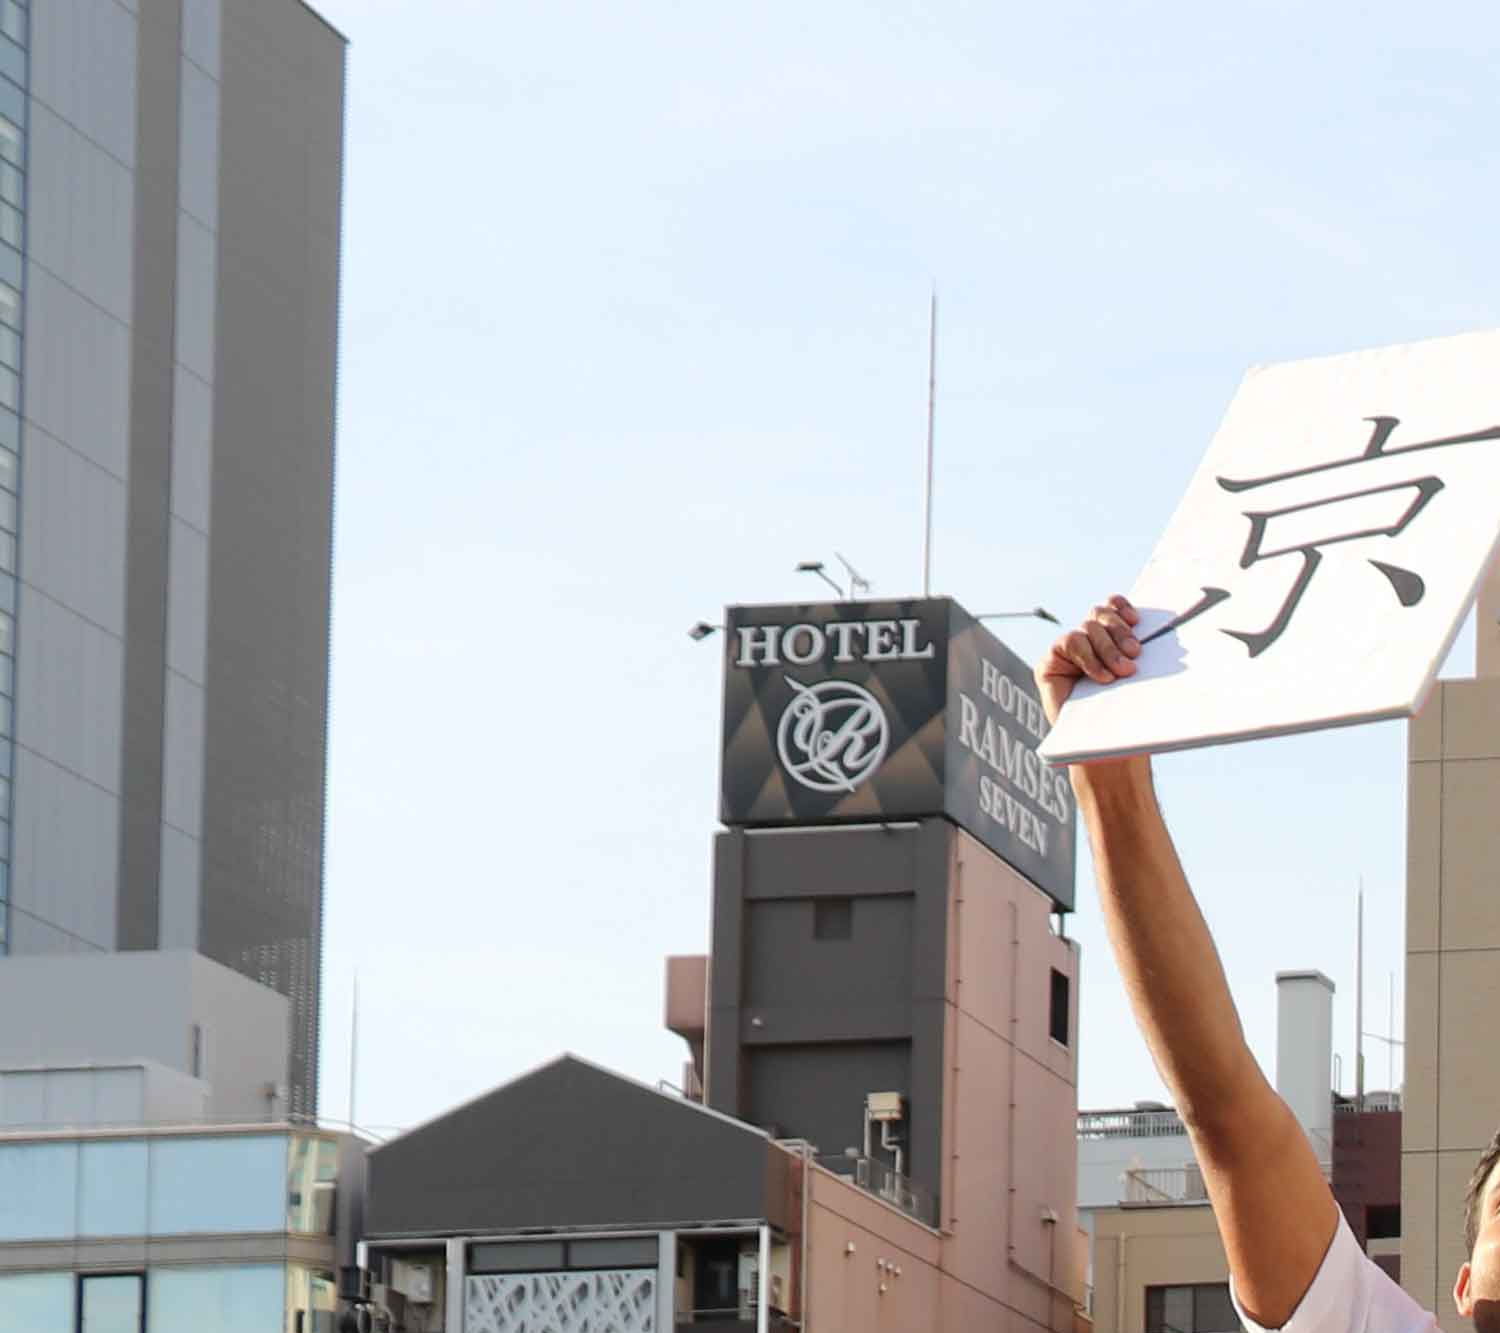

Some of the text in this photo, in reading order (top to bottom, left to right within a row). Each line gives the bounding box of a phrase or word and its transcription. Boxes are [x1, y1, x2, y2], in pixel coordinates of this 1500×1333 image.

[736, 619, 935, 668] HOTEL
[959, 693, 1069, 825] RAMSES
[979, 775, 1048, 857] SEVEN
